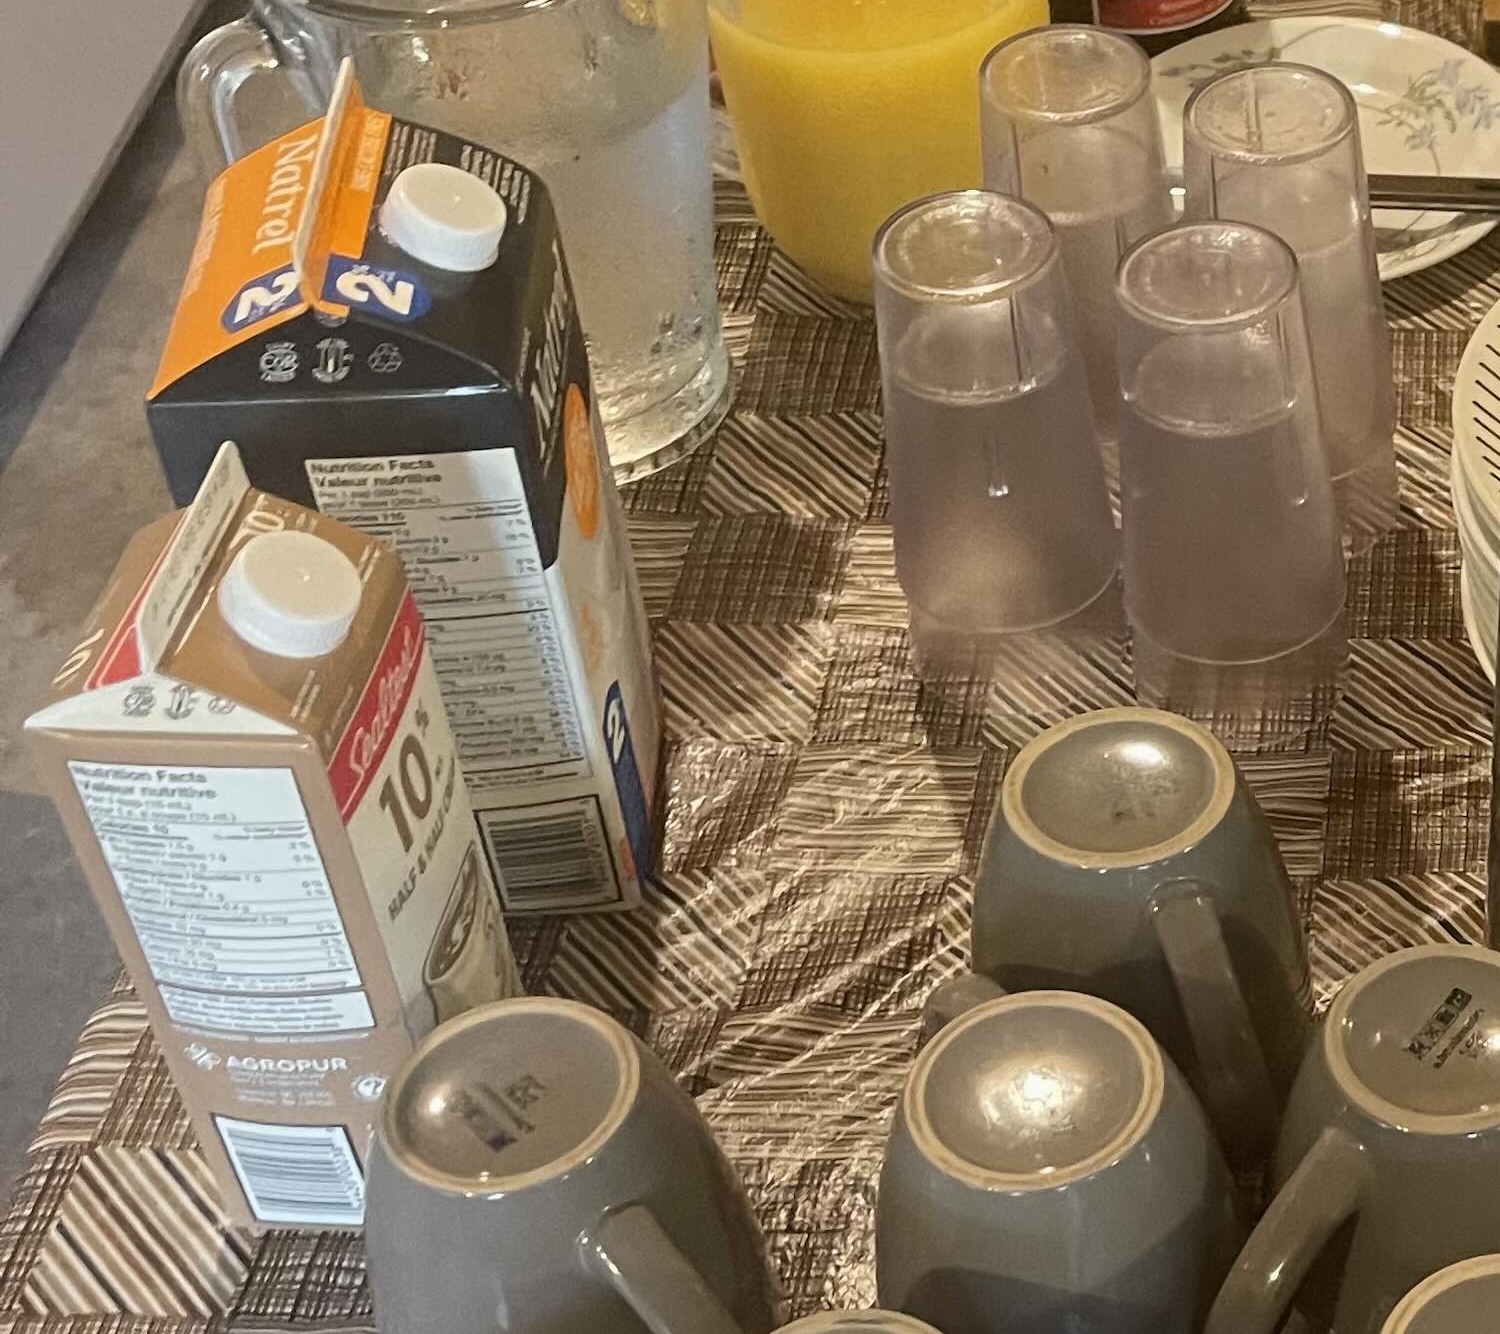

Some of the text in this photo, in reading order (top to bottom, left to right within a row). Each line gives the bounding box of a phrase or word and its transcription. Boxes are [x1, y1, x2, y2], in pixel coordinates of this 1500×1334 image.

[252, 134, 318, 256] Natrel
[310, 459, 435, 474] Nutrition Facts
[314, 473, 442, 488] Valeur nutritive
[156, 769, 208, 784] Facts
[388, 866, 417, 923] HALF
[225, 1055, 348, 1073] AGROPUR
